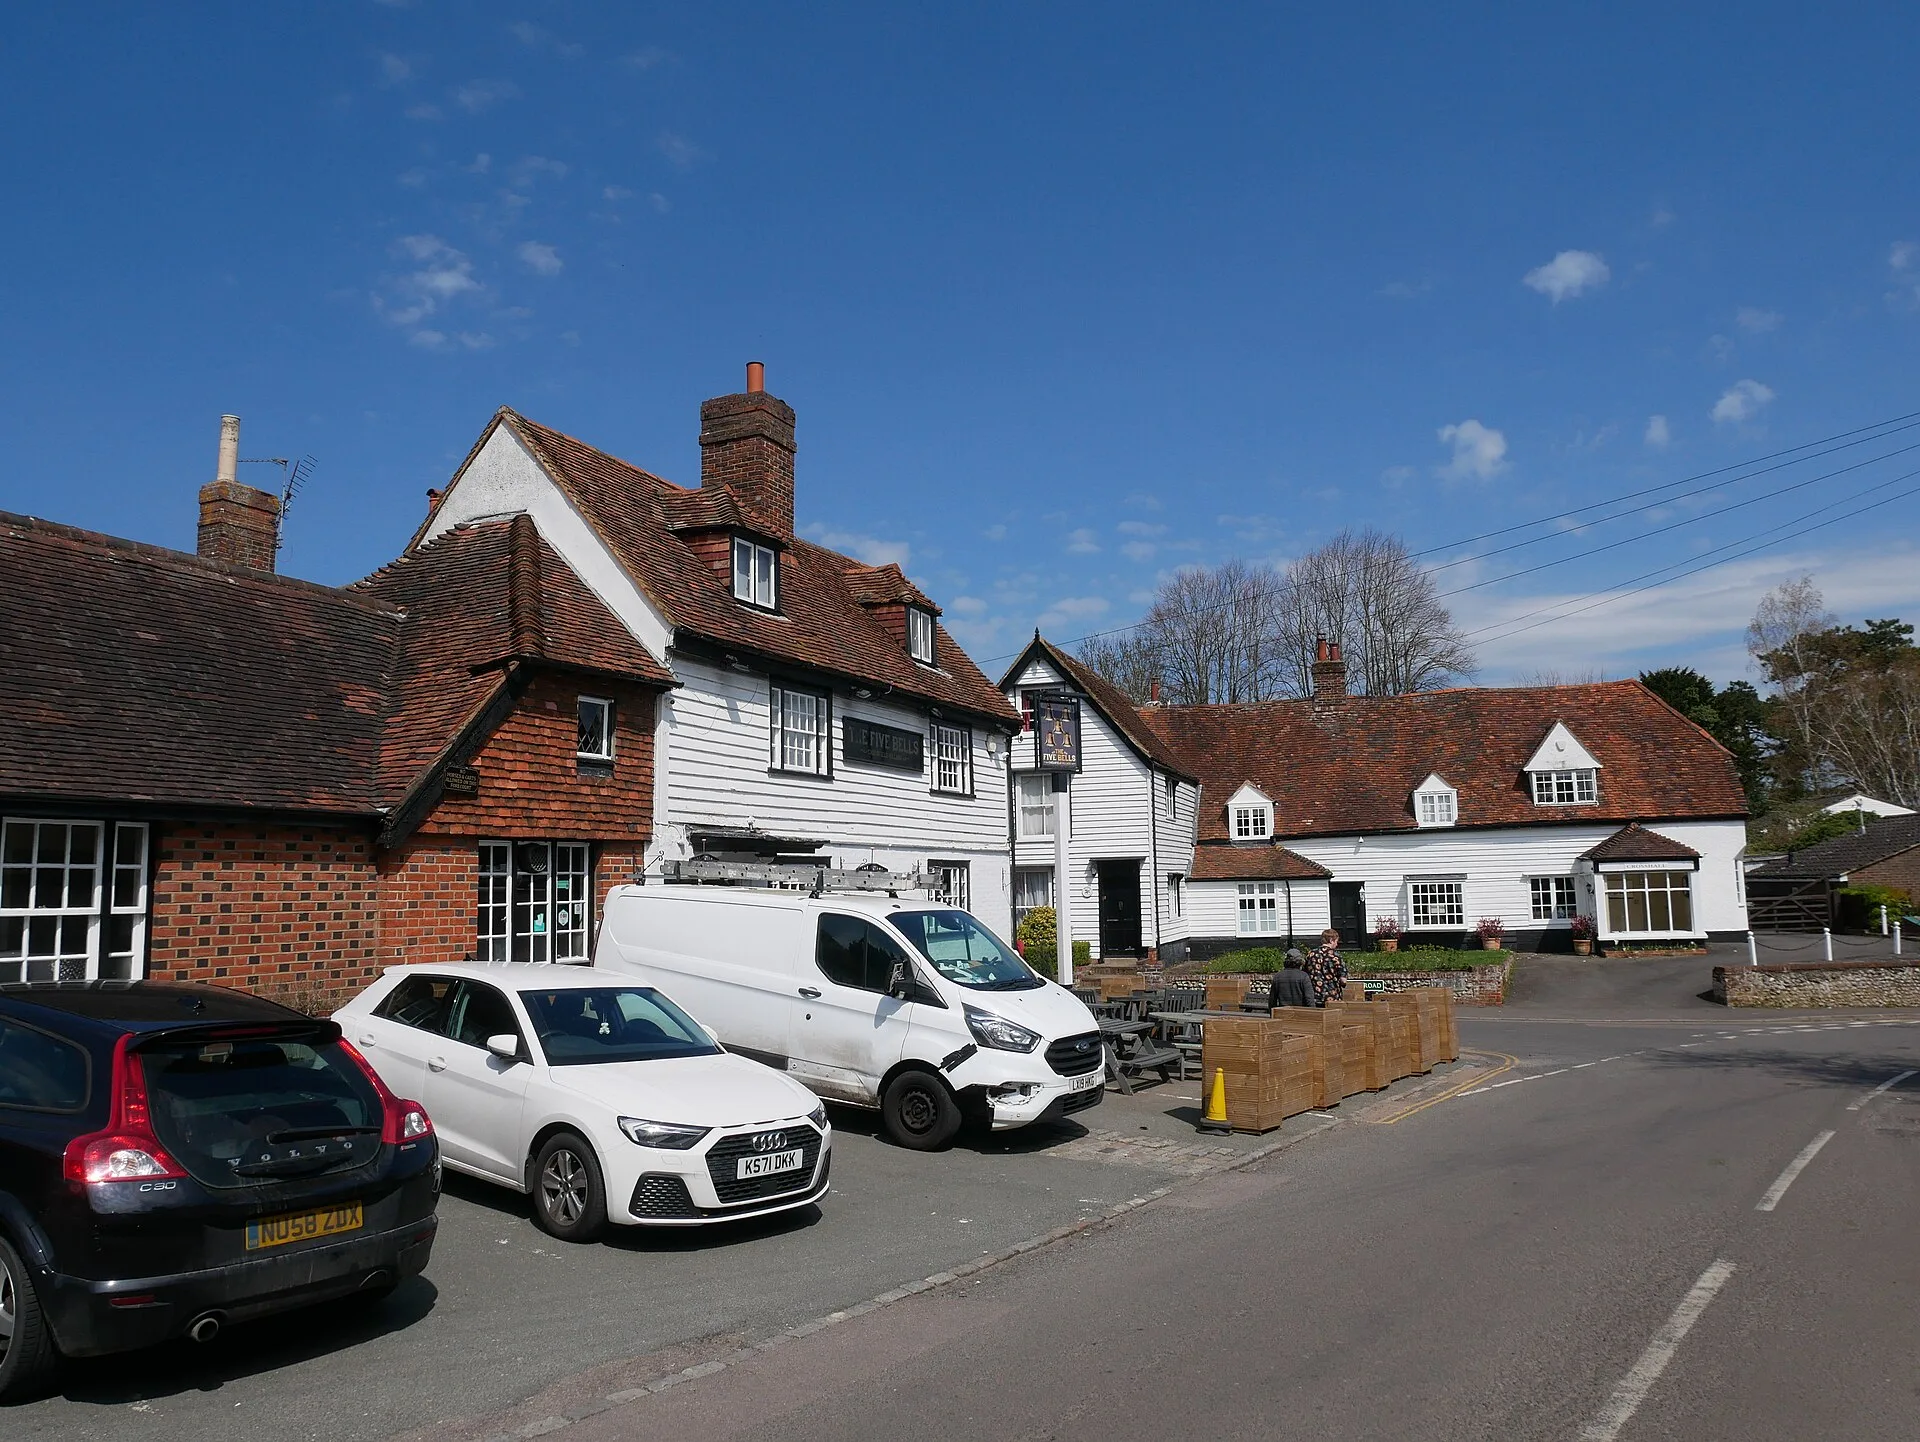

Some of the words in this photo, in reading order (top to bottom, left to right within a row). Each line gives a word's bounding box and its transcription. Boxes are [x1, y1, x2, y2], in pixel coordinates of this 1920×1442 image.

[870, 731, 890, 750] FIVE
[892, 736, 919, 755] BELLS
[1043, 753, 1057, 761] FIVE
[1057, 754, 1076, 762] BELLS
[227, 1141, 353, 1168] VOLVO
[745, 1156, 772, 1175] KS71
[774, 1151, 796, 1169] DKK
[139, 1181, 176, 1193] C30
[261, 1213, 317, 1243] NU58
[323, 1204, 360, 1232] ZDX
